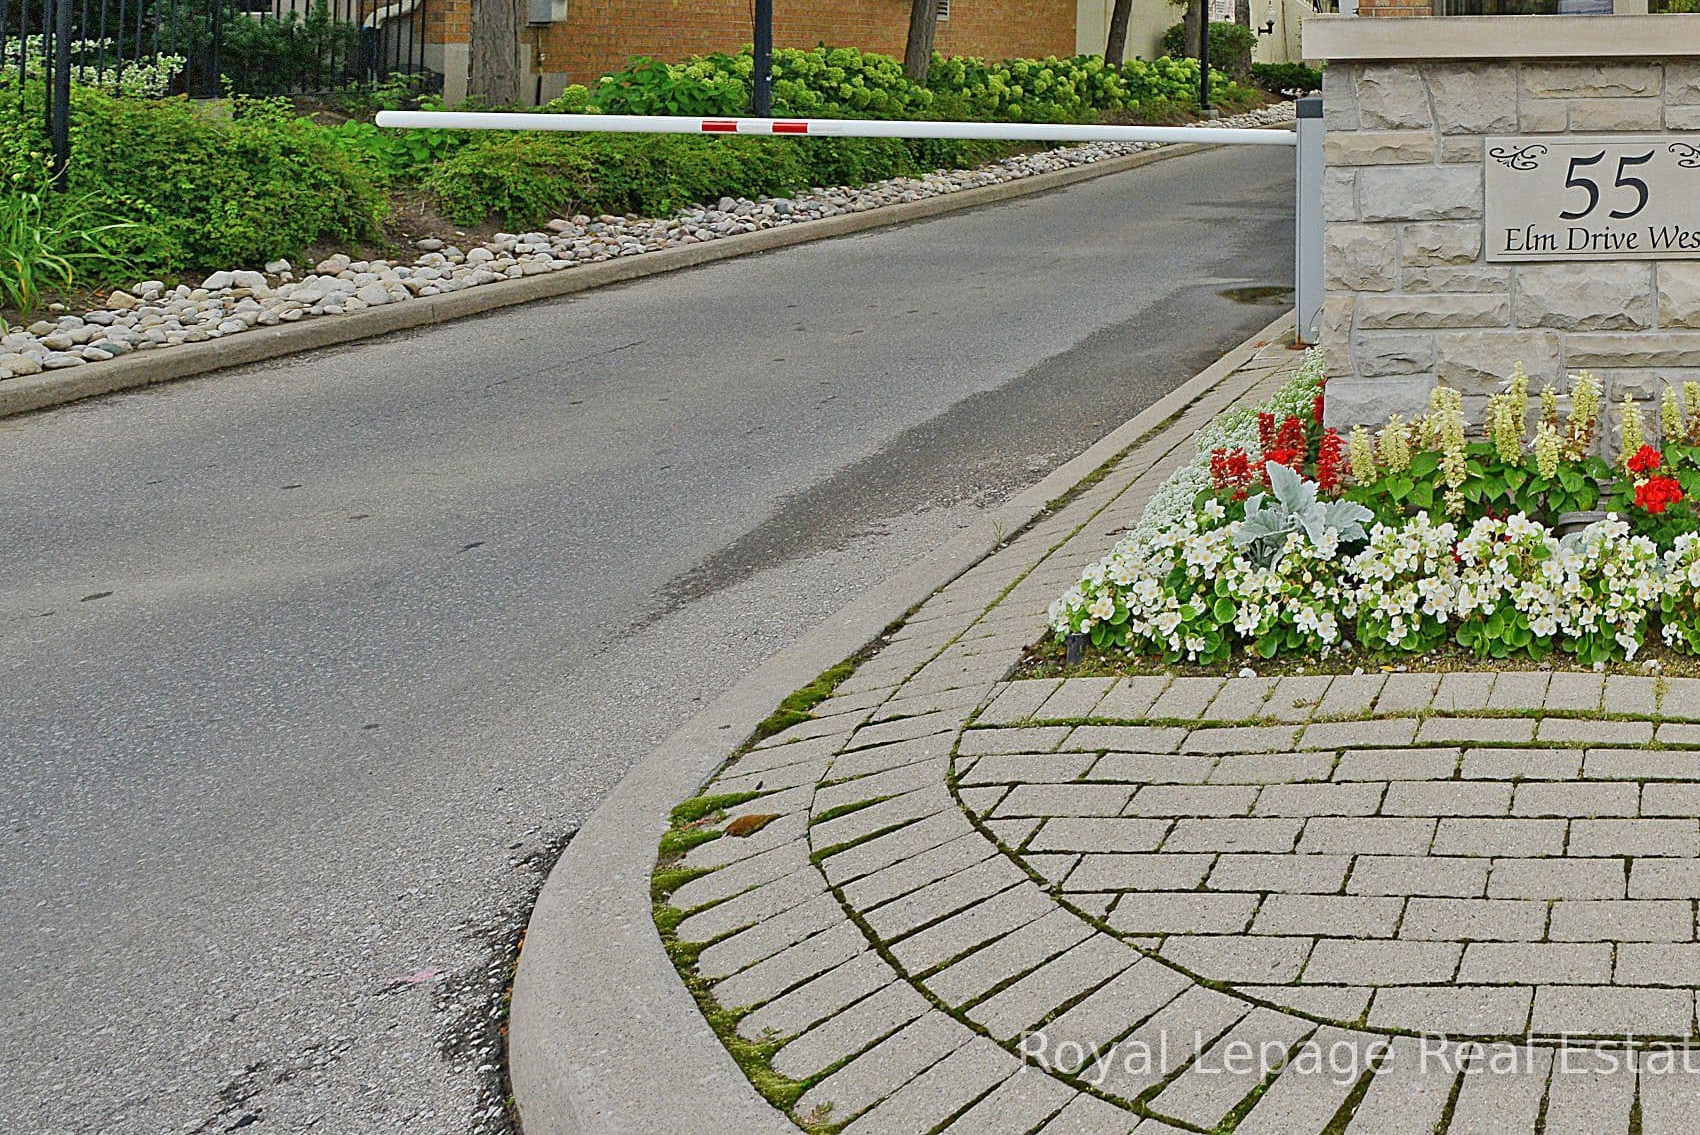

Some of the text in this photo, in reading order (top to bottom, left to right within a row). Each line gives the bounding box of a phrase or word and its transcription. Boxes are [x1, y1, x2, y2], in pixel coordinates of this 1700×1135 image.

[1559, 149, 1656, 220] 55
[1504, 224, 1557, 251] Elm
[1566, 226, 1638, 251] Drive
